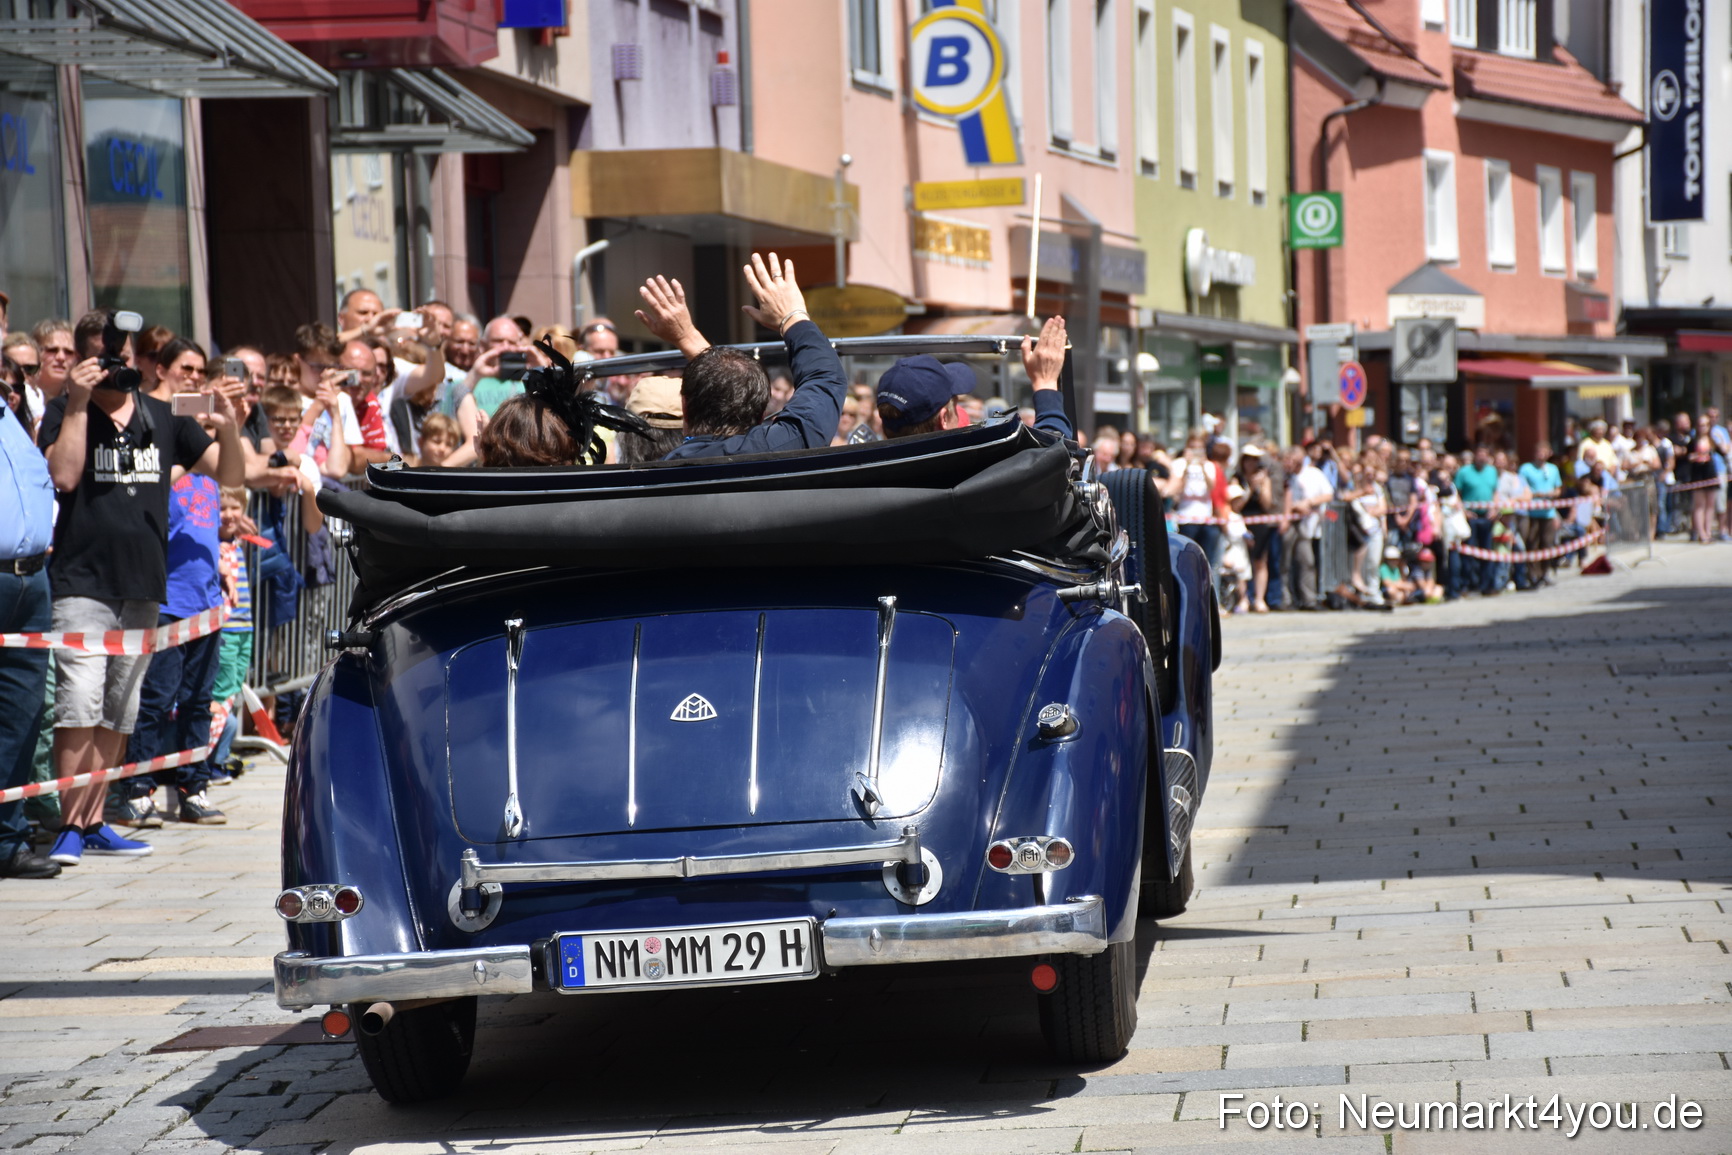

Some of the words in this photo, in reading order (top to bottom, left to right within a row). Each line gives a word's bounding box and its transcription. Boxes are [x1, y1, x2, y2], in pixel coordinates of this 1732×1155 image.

[925, 36, 970, 87] B
[110, 138, 163, 198] CECIL
[1684, 111, 1700, 201] TOM
[133, 442, 160, 472] ask
[568, 966, 578, 979] D
[594, 938, 641, 979] NM
[665, 934, 713, 975] MM
[722, 931, 766, 971] 29
[779, 928, 803, 968] H
